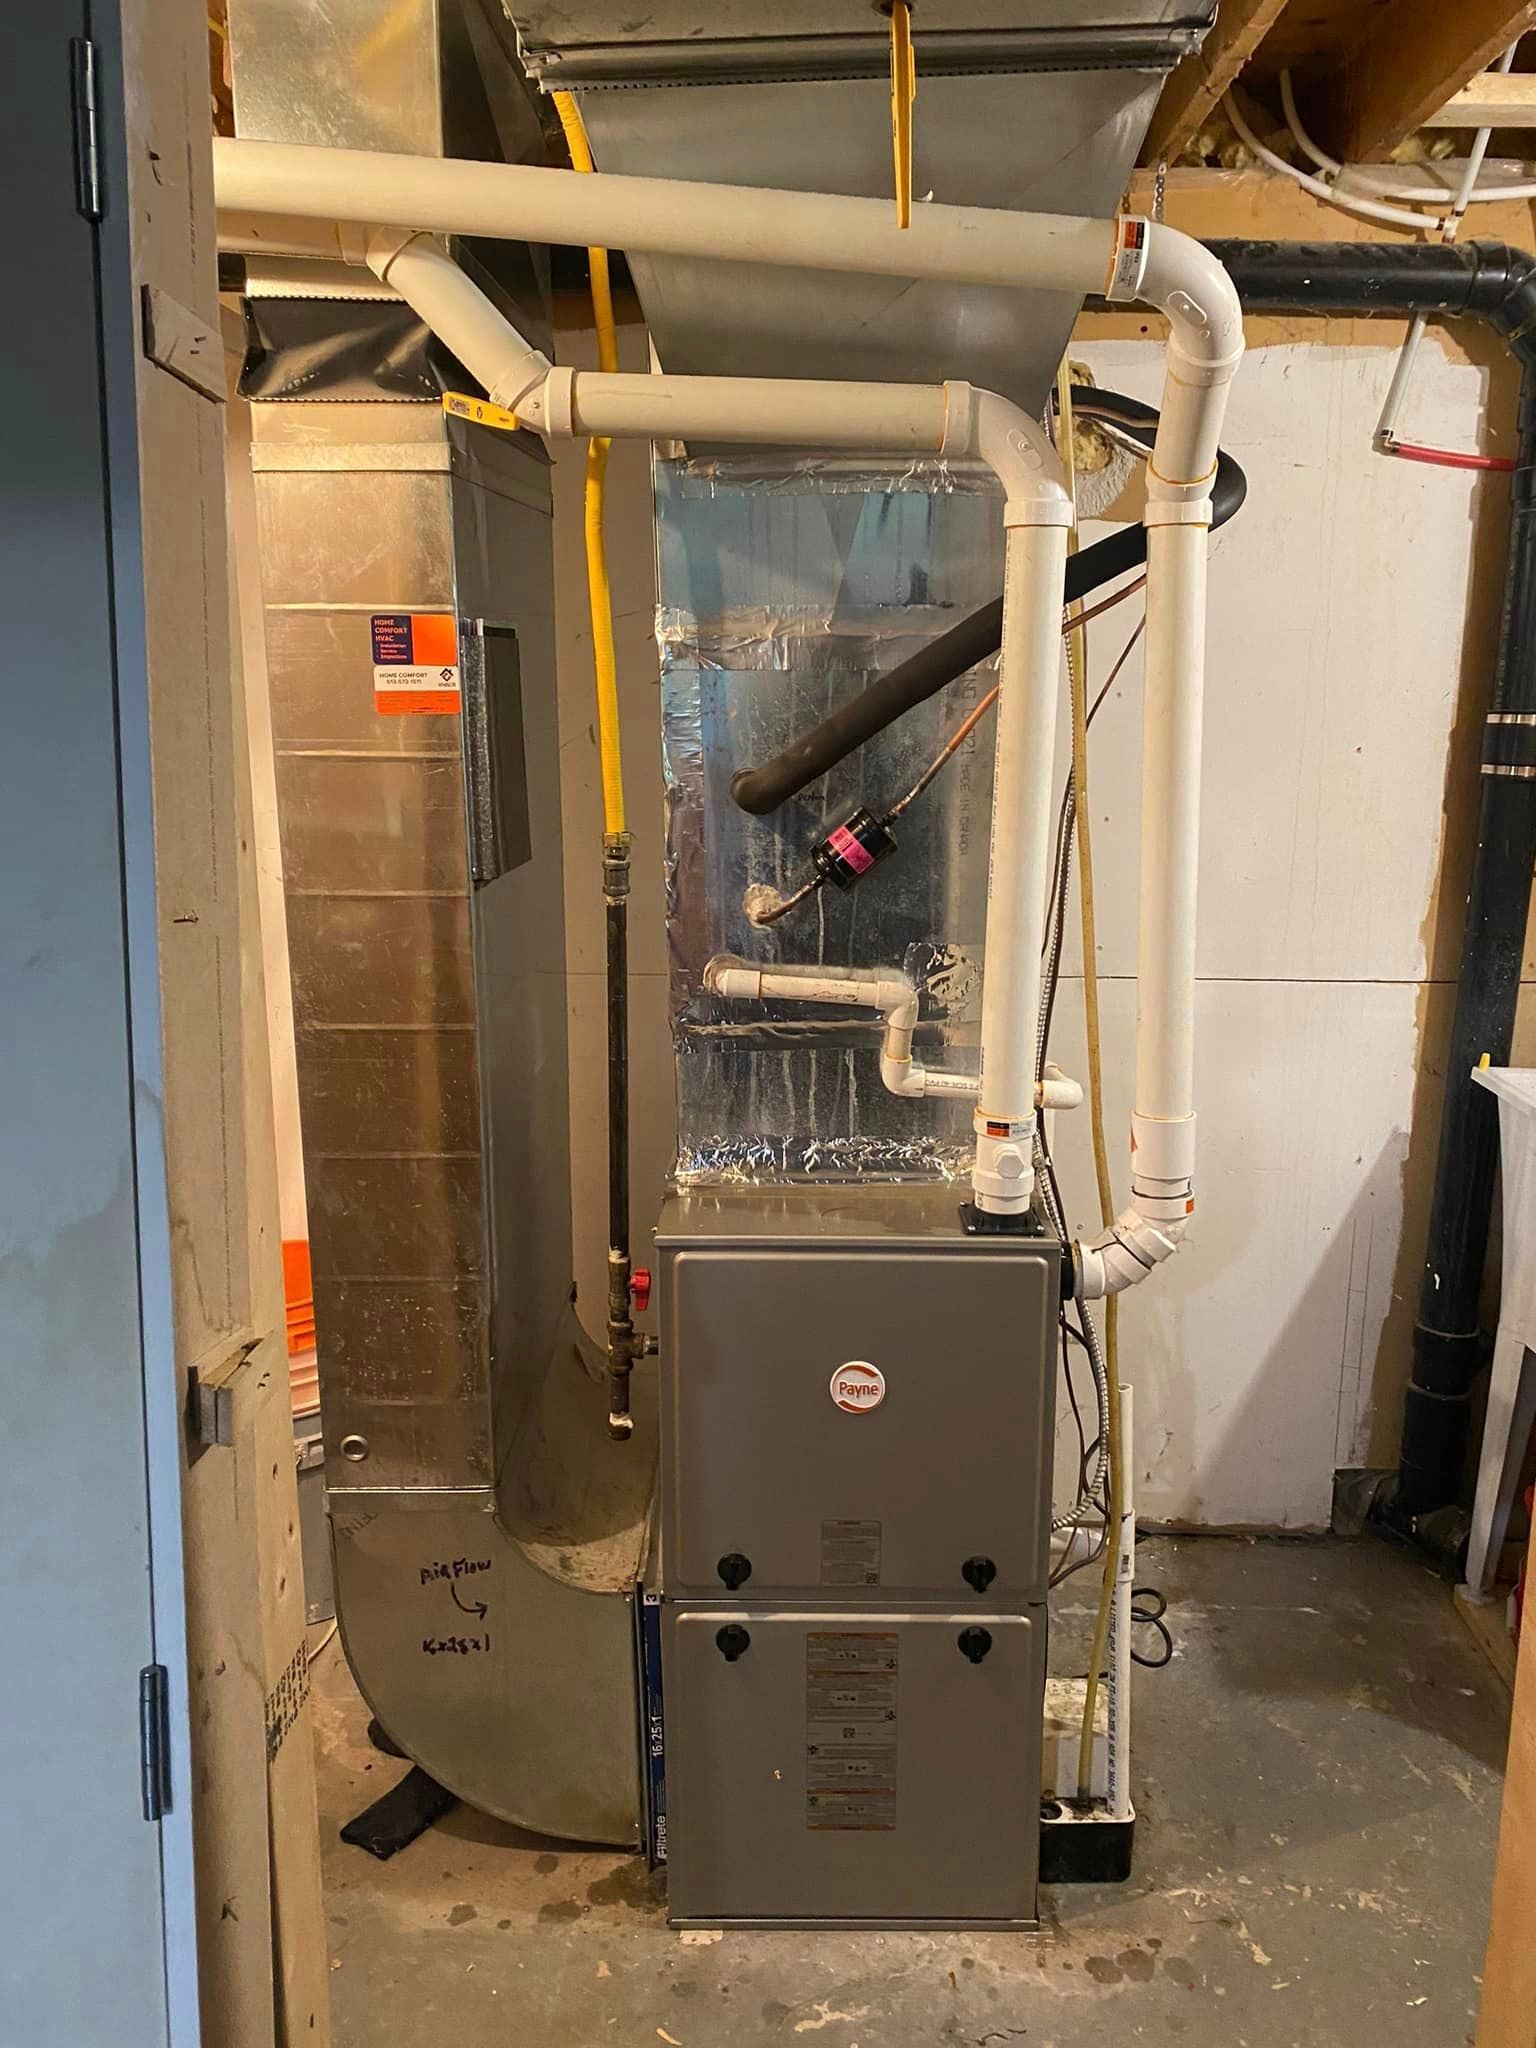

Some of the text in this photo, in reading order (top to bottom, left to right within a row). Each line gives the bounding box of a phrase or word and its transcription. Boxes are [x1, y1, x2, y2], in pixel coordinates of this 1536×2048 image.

[374, 626, 408, 634] COMFORT
[839, 1381, 879, 1398] Payne
[655, 1815, 668, 1860] Filtrete
